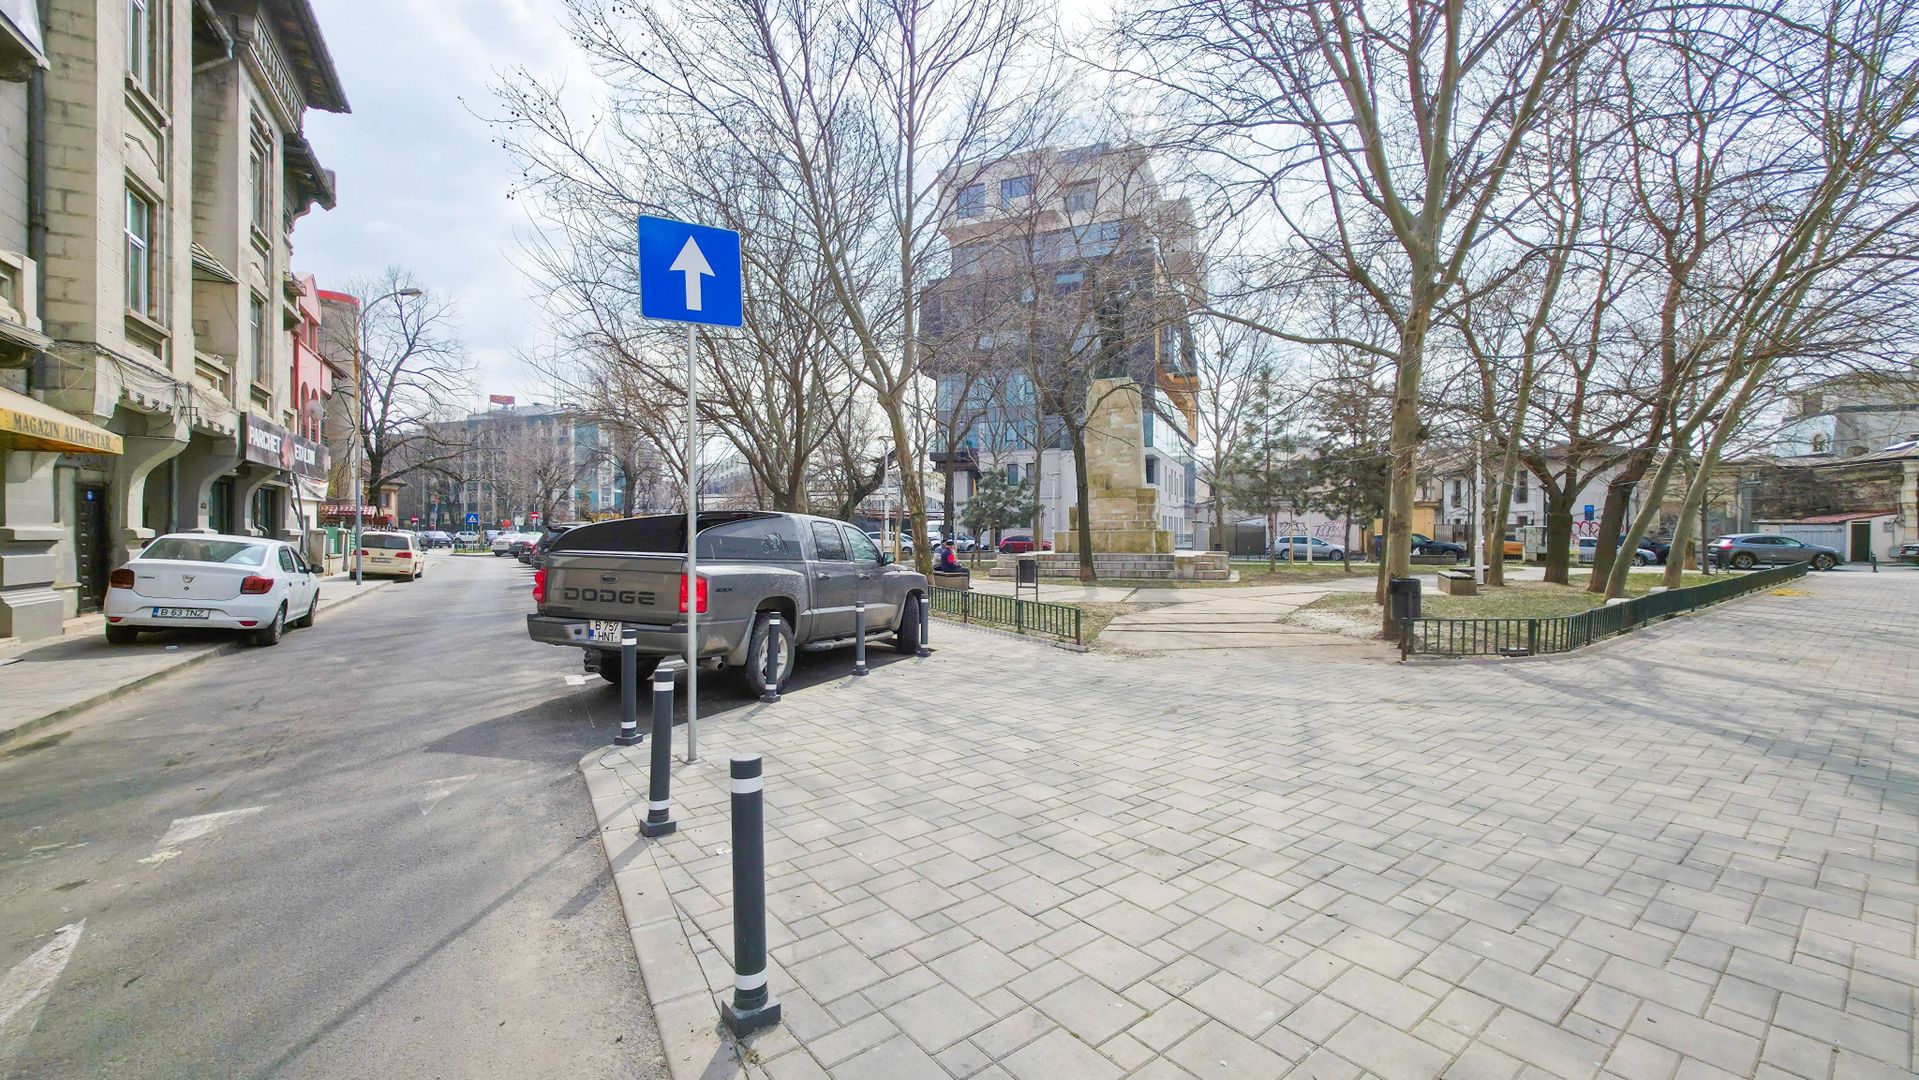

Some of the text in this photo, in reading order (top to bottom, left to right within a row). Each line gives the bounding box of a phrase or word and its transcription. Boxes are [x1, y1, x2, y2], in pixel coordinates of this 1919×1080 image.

[13, 412, 111, 450] MAGAZIN ALIMENTAR
[248, 425, 281, 454] PARCHET
[564, 587, 655, 605] DODGE
[171, 608, 182, 616] 63
[185, 609, 204, 617] TNZ
[595, 620, 618, 631] B 757
[598, 631, 615, 641] HNT
